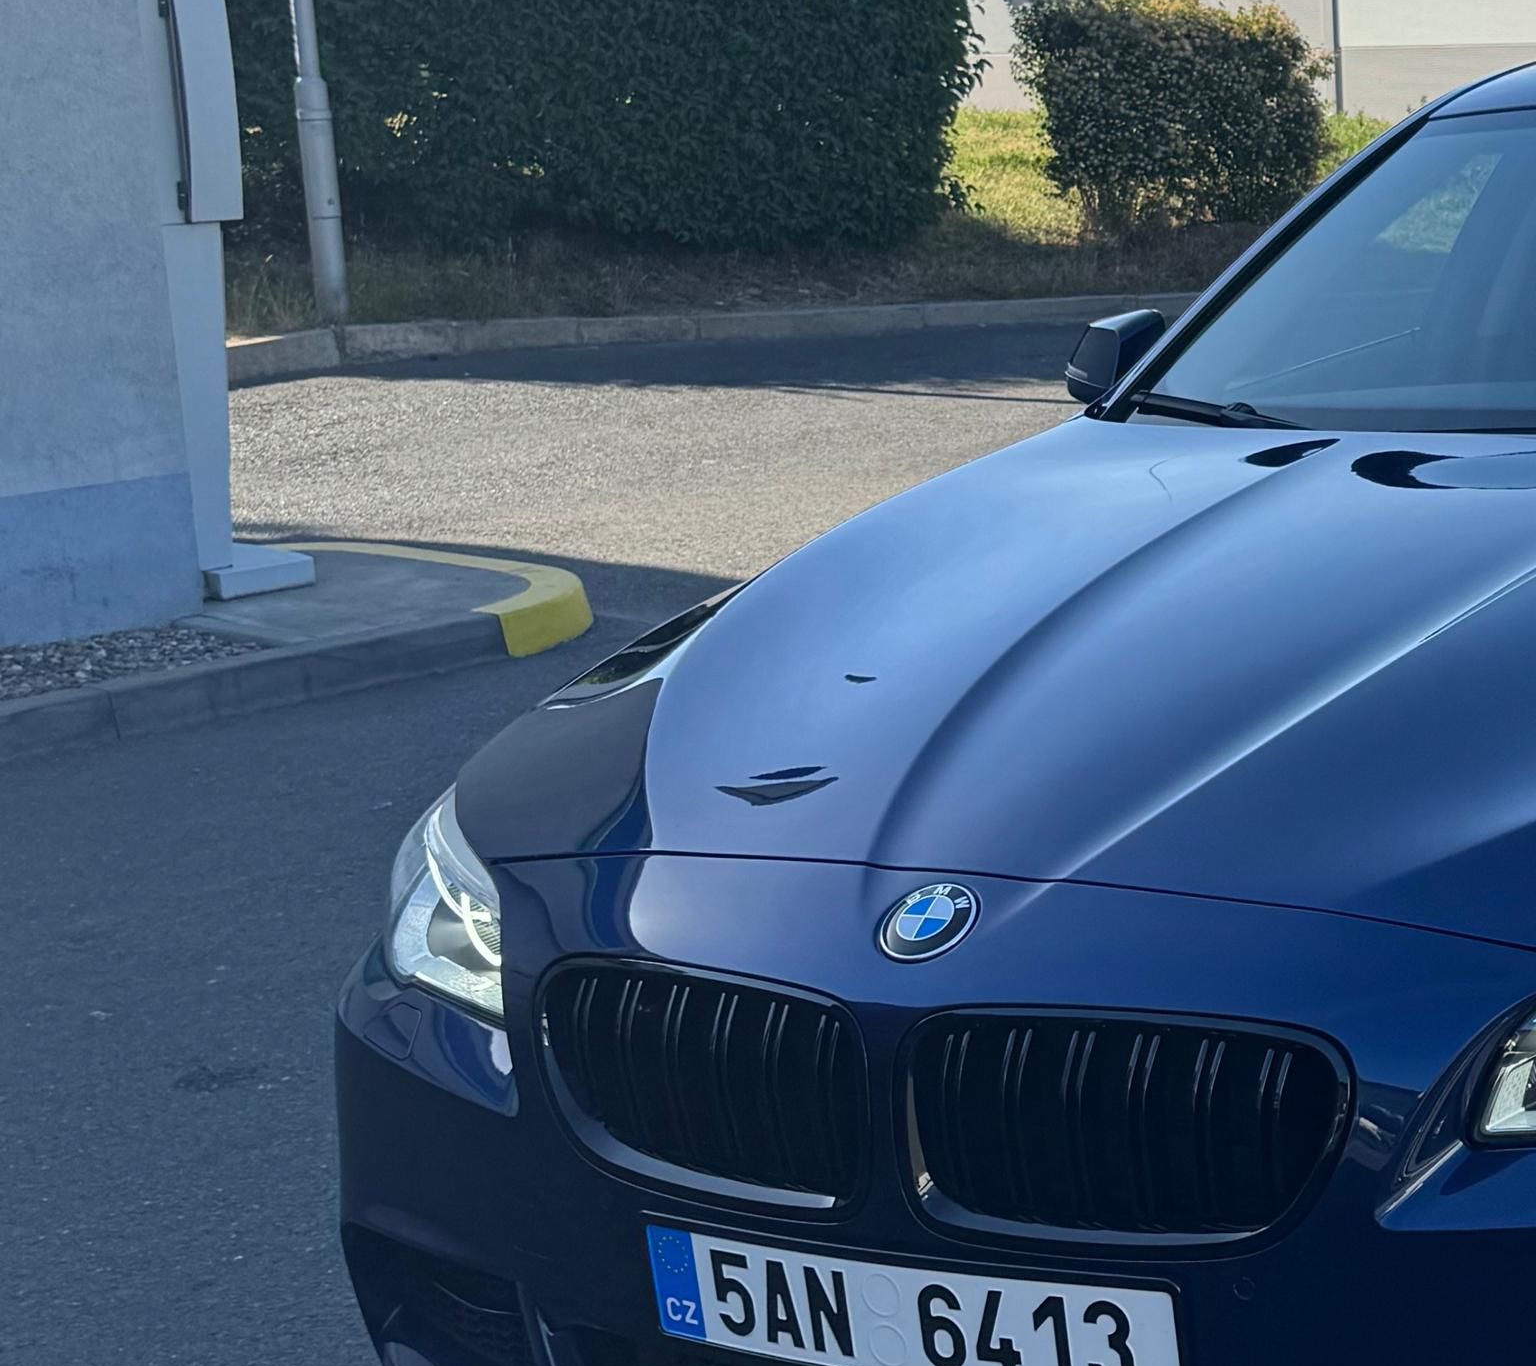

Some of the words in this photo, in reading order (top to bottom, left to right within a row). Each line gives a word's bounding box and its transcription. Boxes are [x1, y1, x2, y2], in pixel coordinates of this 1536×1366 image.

[906, 885, 971, 909] BMW
[666, 1297, 699, 1325] CZ
[709, 1249, 855, 1357] 5AN
